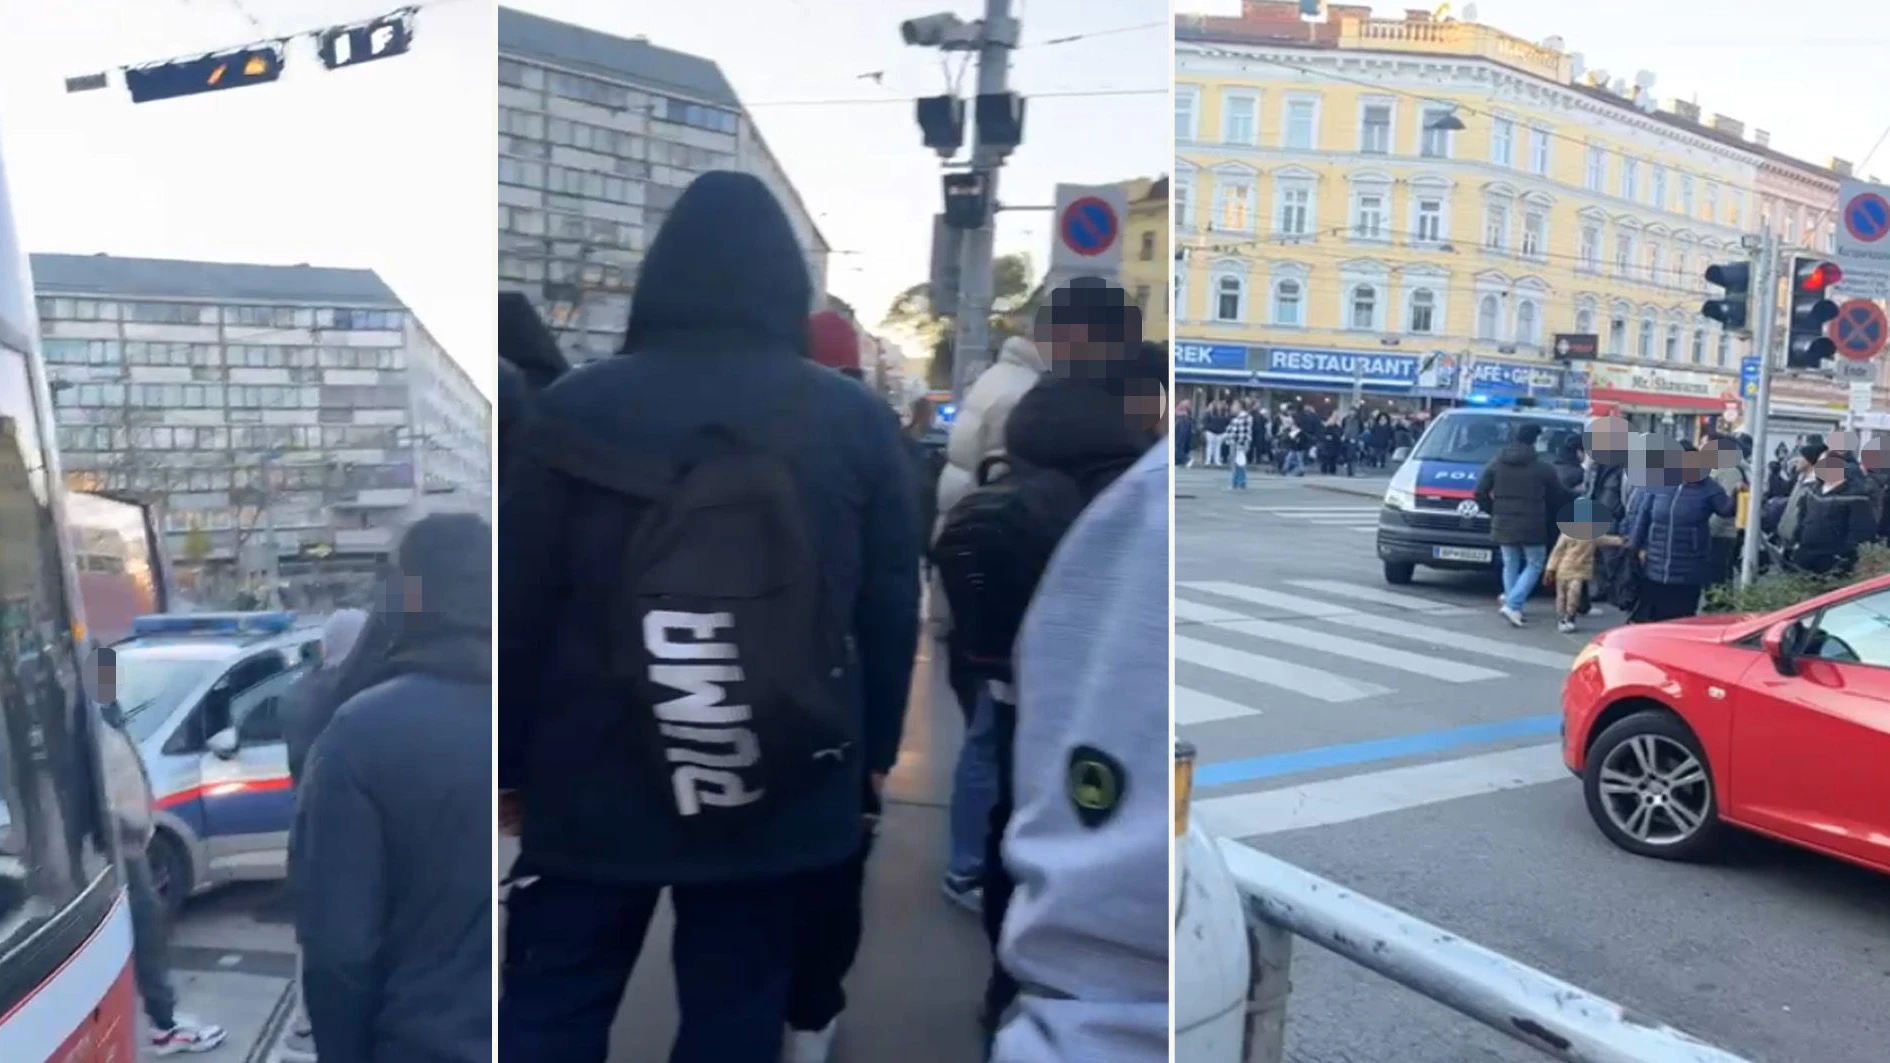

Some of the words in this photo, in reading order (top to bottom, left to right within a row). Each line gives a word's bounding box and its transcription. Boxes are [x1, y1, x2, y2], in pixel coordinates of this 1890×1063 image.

[1273, 352, 1414, 375] RESTAURANT
[1473, 363, 1501, 382] AFÉ
[642, 610, 764, 816] PUMA
